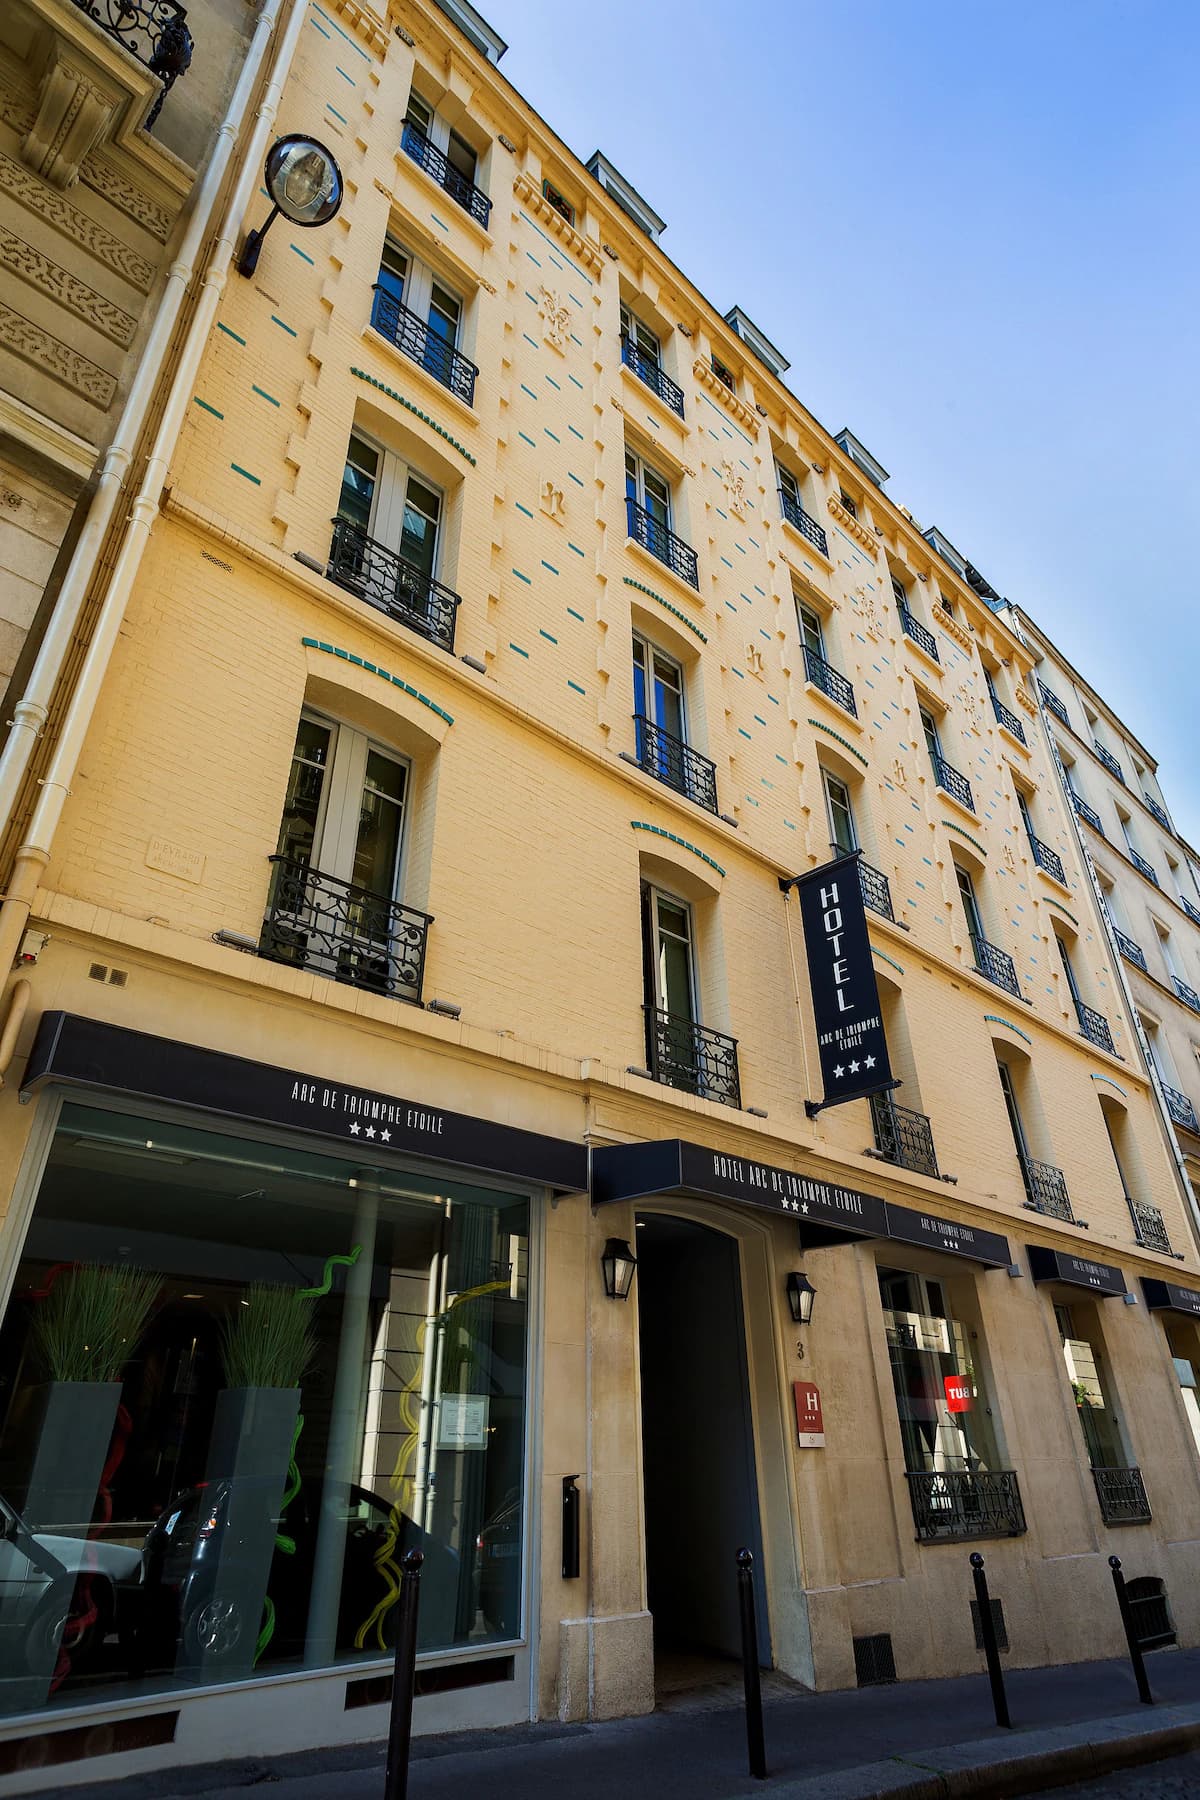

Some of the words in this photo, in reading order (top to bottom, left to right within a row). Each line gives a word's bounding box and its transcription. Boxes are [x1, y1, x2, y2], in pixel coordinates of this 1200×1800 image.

[820, 882, 855, 1012] HOTEL
[291, 1081, 316, 1104] ARC
[322, 1089, 338, 1110] DE
[343, 1094, 401, 1125] TRIOMPHE
[407, 1110, 444, 1135] ETOILE
[713, 1155, 745, 1183] HOTEL
[749, 1165, 768, 1189] ARC
[771, 1171, 784, 1194] DE
[786, 1175, 832, 1206] TRIOMPHE
[834, 1189, 864, 1215] ETOILE
[797, 1341, 805, 1360] 3
[806, 1392, 819, 1411] H
